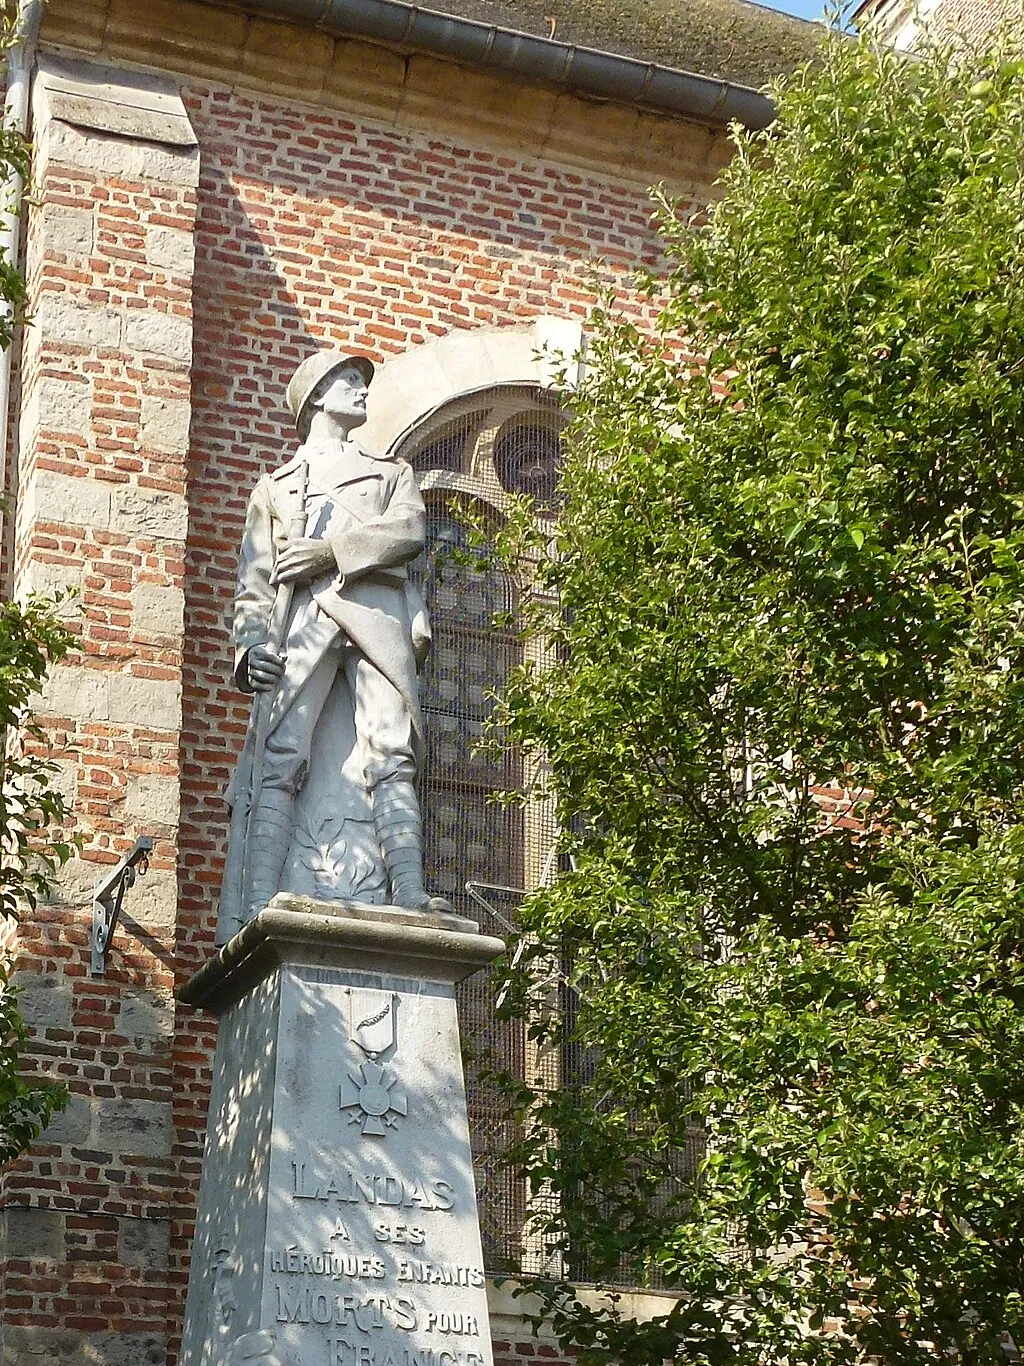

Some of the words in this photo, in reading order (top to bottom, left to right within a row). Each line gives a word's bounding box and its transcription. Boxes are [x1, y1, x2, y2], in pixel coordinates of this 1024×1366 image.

[291, 1161, 455, 1212] LANDAS
[330, 1217, 350, 1242] A
[375, 1222, 426, 1244] SES
[397, 1261, 486, 1289] ENFANTS
[275, 1285, 417, 1336] MORTS
[426, 1311, 480, 1336] POUR
